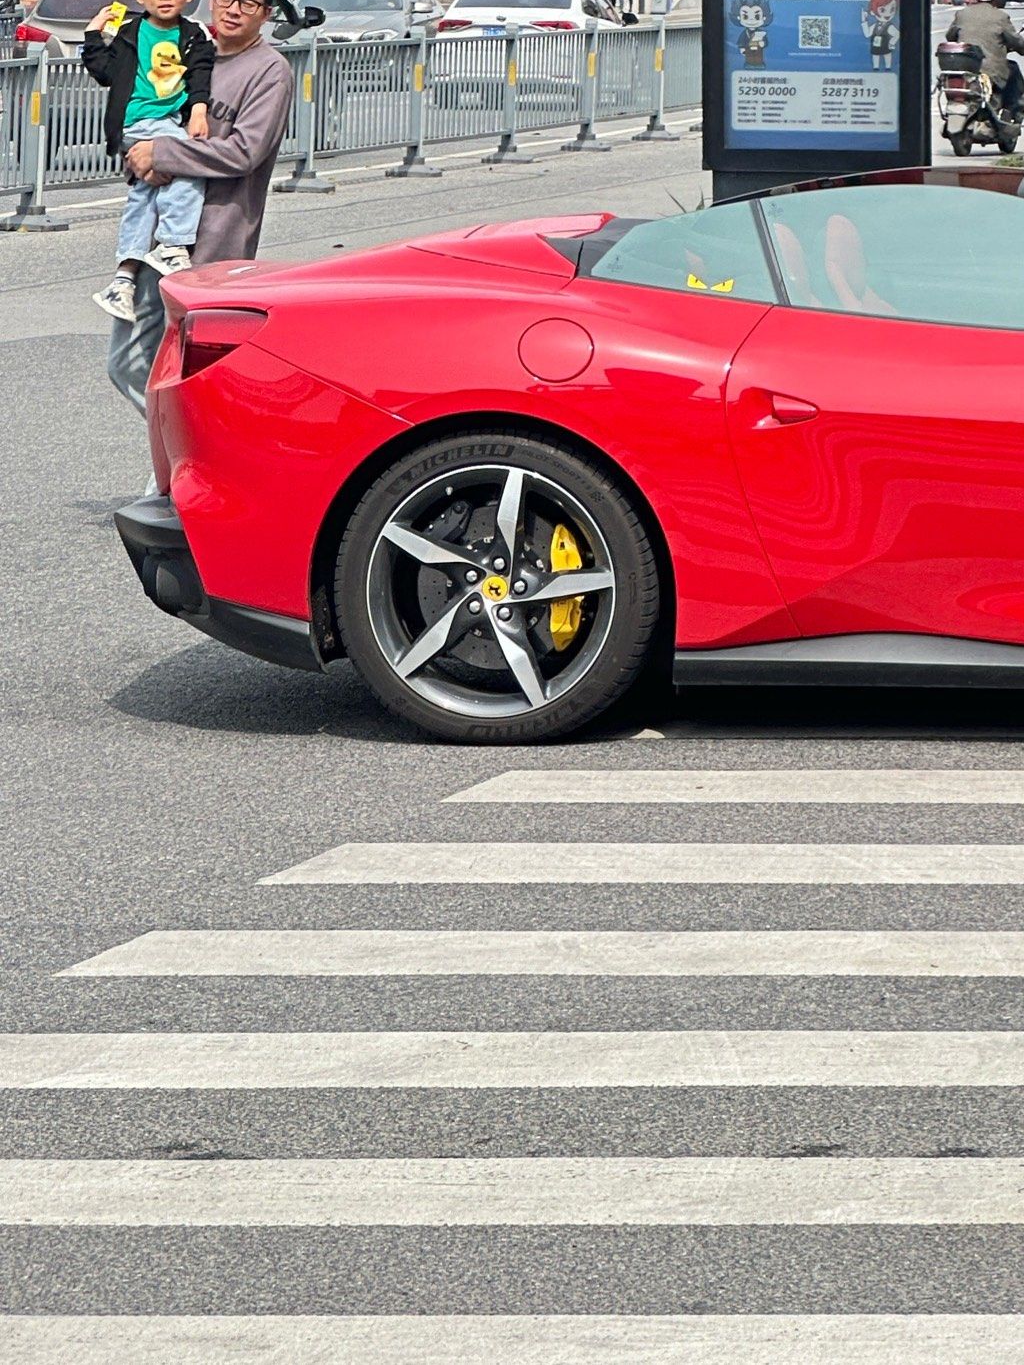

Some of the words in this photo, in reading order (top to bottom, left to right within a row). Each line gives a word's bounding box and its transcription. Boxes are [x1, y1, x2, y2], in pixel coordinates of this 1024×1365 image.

[738, 86, 766, 96] 5290
[768, 87, 797, 96] 0000
[821, 87, 849, 97] 5287
[851, 88, 879, 98] 3119
[408, 444, 512, 481] MICHELIN
